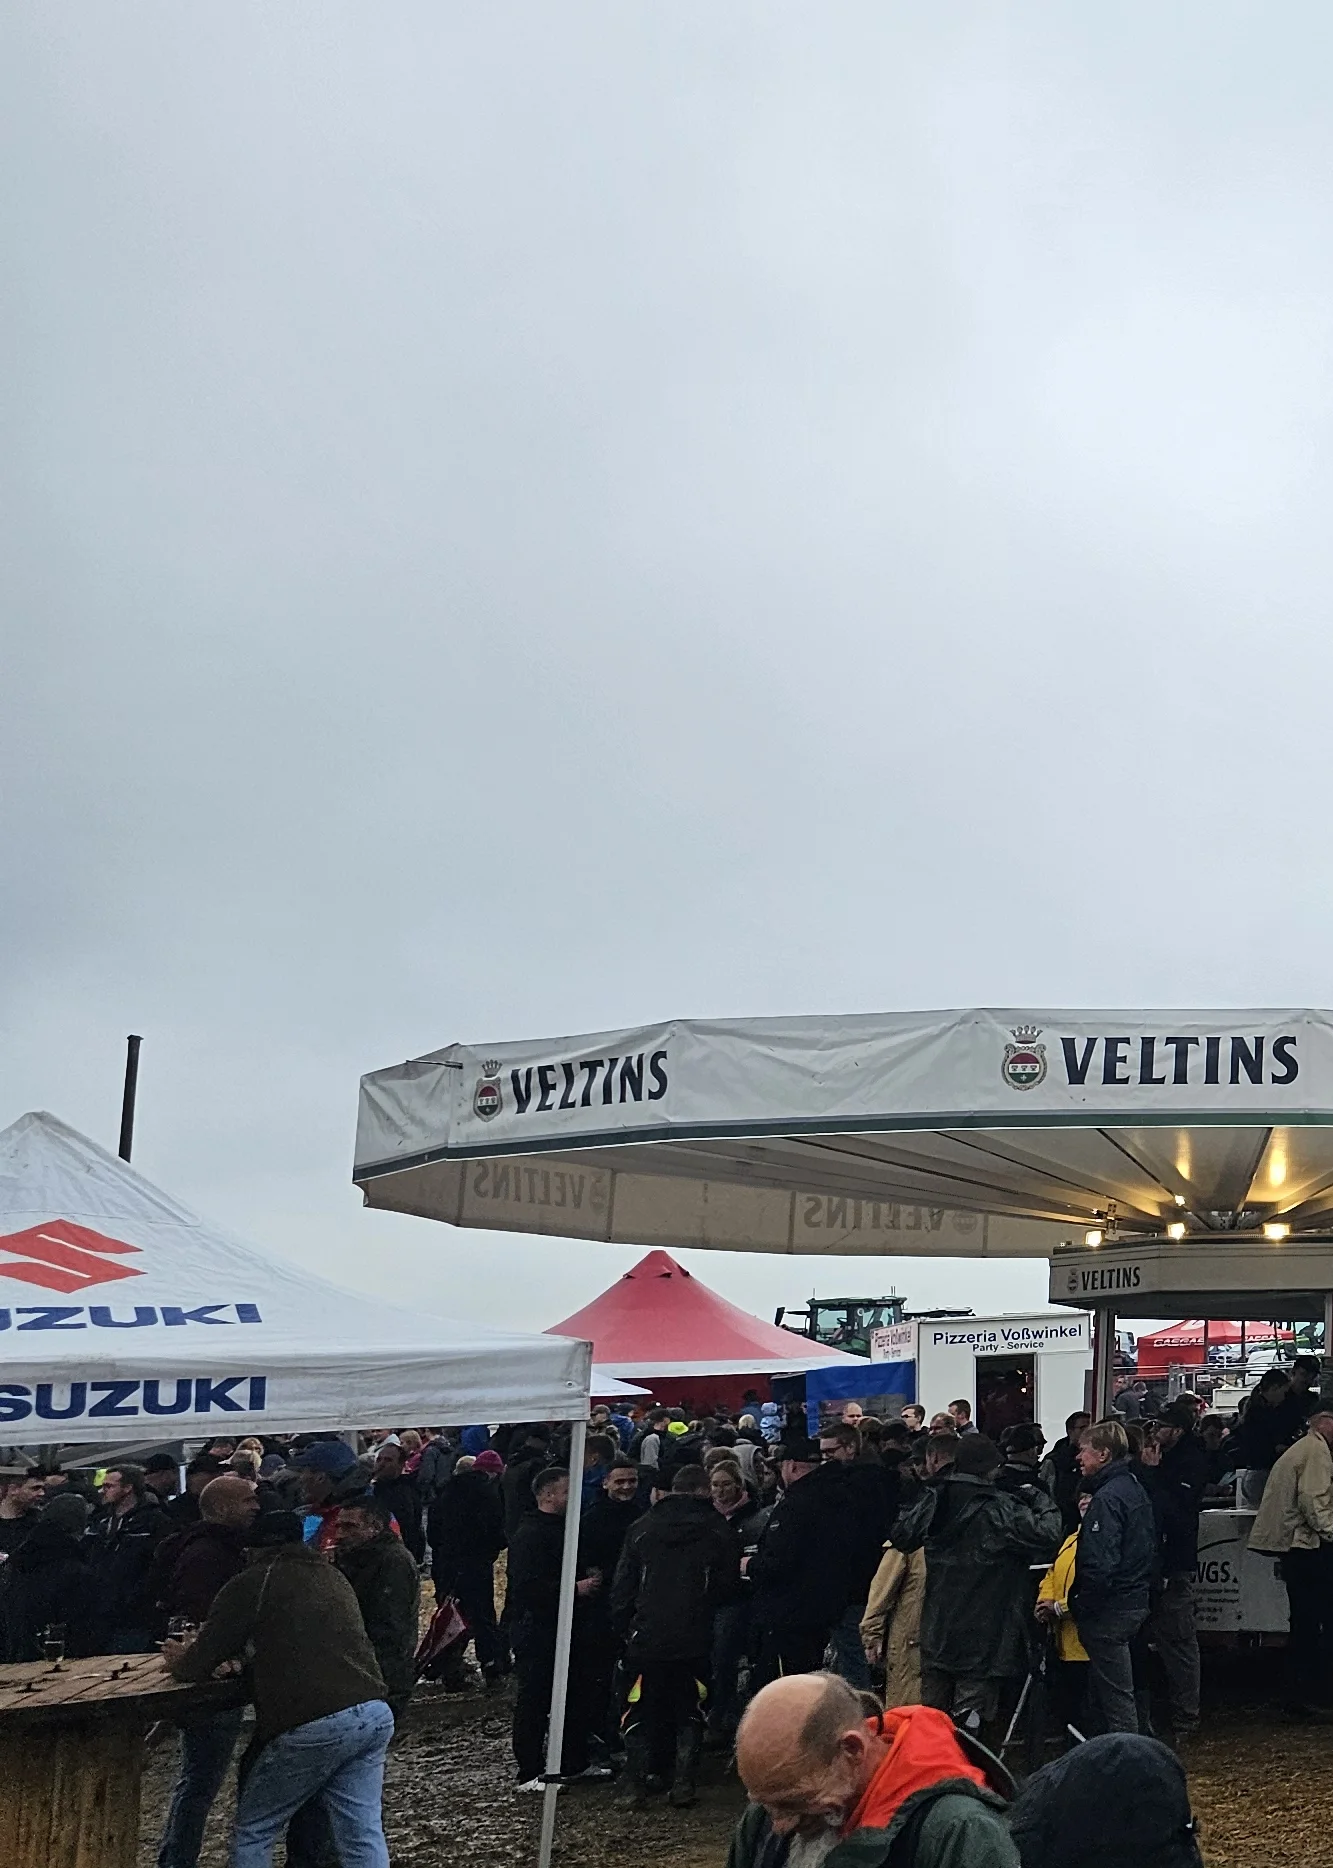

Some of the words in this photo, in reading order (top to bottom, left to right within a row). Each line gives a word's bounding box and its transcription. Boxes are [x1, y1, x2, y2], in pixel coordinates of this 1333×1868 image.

[1060, 1035, 1299, 1085] VELTINS
[510, 1050, 668, 1115] VELTINS
[1080, 1266, 1141, 1291] VELTINS
[0, 1303, 263, 1331] ZUKI
[933, 1329, 997, 1346] Pizzeria
[1001, 1324, 1082, 1341] Voßwinkel
[972, 1343, 998, 1354] Party
[1006, 1340, 1044, 1350] Service
